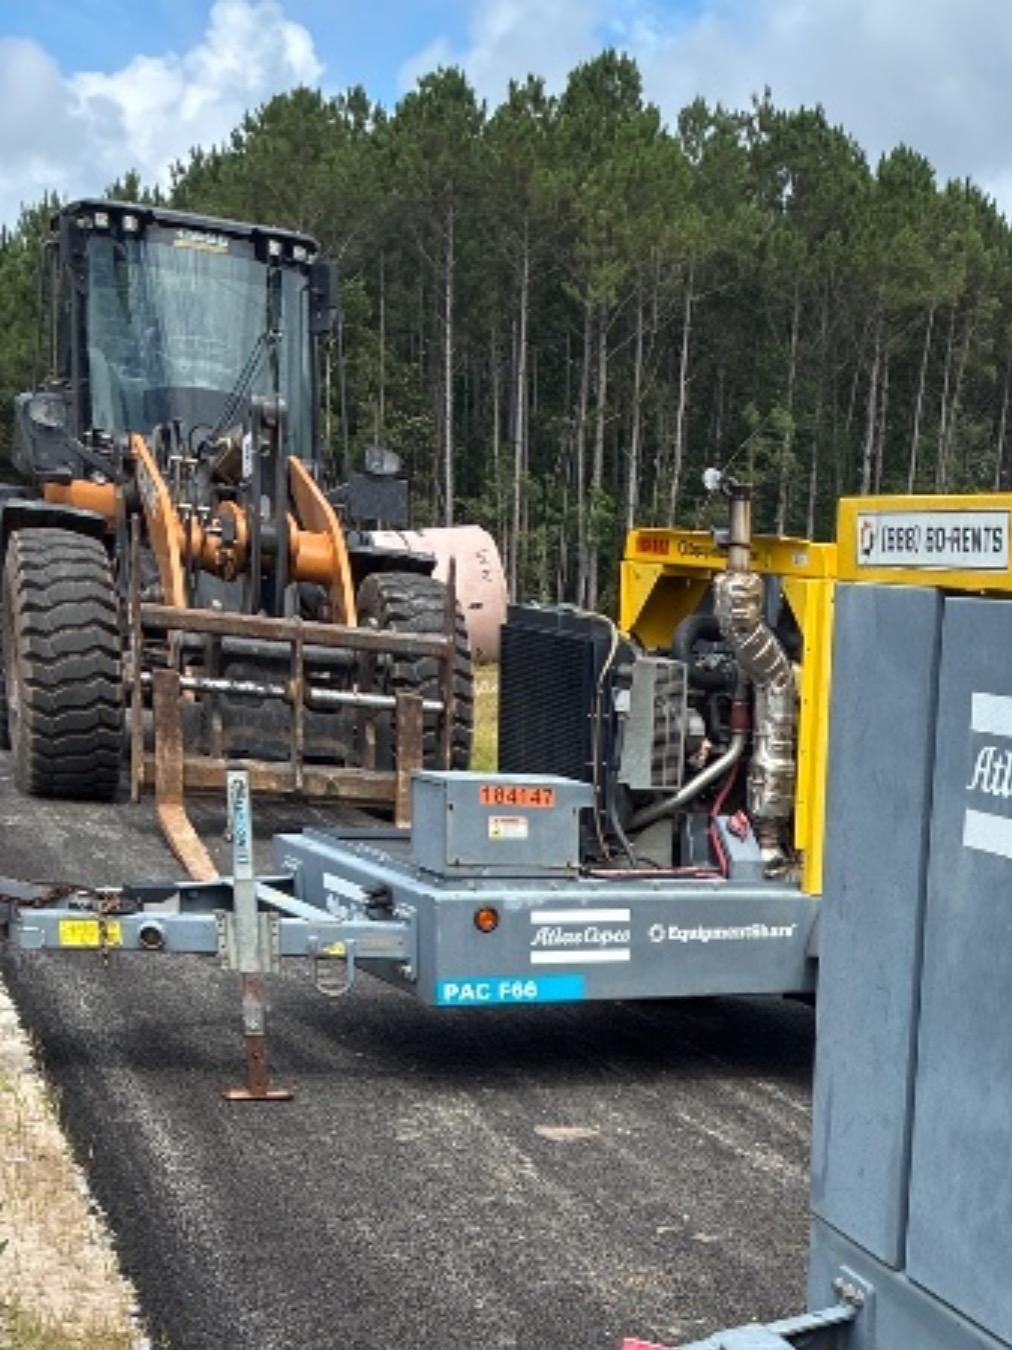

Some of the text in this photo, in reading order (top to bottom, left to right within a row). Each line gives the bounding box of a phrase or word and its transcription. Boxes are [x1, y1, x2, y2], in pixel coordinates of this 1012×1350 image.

[530, 926, 631, 946] Atlas Copco
[443, 983, 490, 1001] PAC
